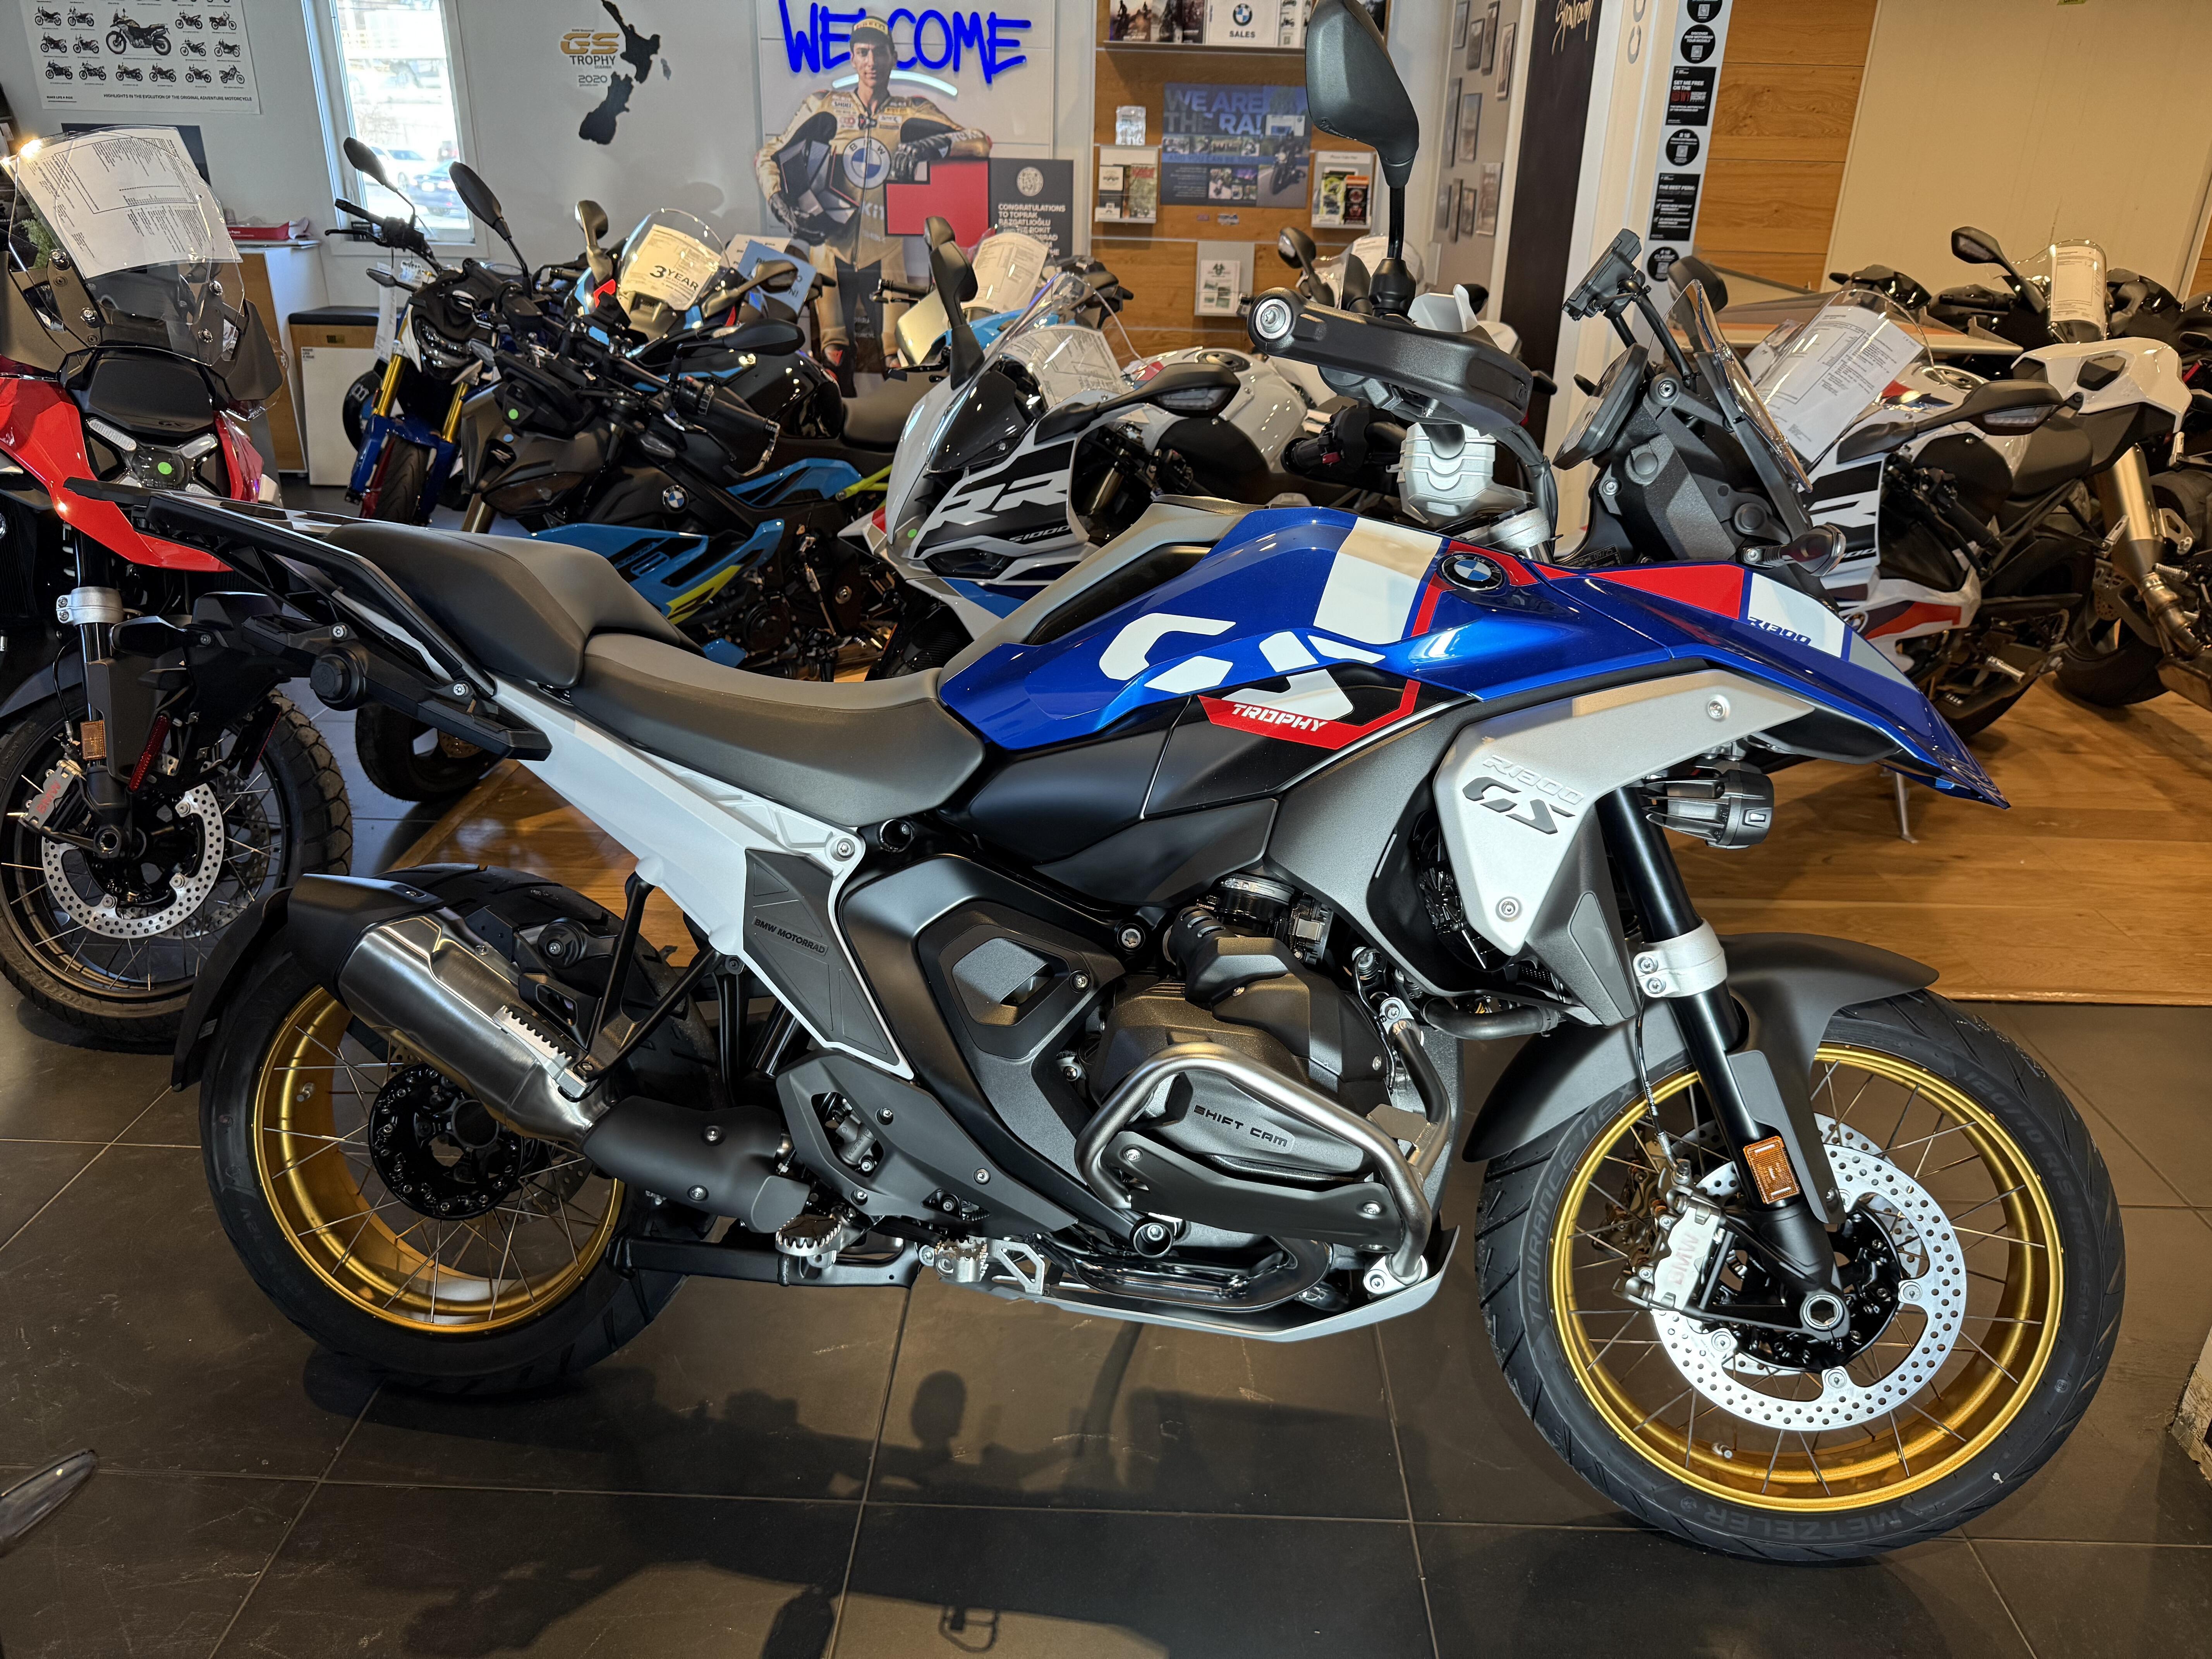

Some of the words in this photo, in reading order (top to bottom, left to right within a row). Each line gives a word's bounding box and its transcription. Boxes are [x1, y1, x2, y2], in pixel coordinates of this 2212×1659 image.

[560, 33, 620, 55] GS
[778, 0, 1031, 84] WECOME
[569, 55, 616, 65] TROPHY
[578, 75, 608, 83] 2020
[1164, 89, 1209, 113] WE
[1211, 91, 1264, 114] ARE
[1163, 111, 1213, 135] THE
[998, 203, 1066, 212] CONGRATULATIONS
[649, 265, 667, 278] 3
[668, 268, 699, 292] YEAR
[1008, 524, 1071, 543] S1000
[1454, 555, 1502, 574] BMW
[1593, 548, 1613, 560] 09/25
[1748, 616, 1812, 646] R1300
[1231, 703, 1330, 732] TROPHY
[1482, 754, 1585, 805] R1300
[37, 779, 61, 814] BMW
[754, 918, 777, 933] BMW
[777, 928, 826, 954] MOTORRAD
[1194, 1104, 1244, 1130] SHIFT
[1250, 1127, 1288, 1147] CAM
[1526, 1144, 1578, 1324] TOURANCE
[1667, 1231, 1699, 1285] BMW
[1702, 1503, 1904, 1541] METZELER
